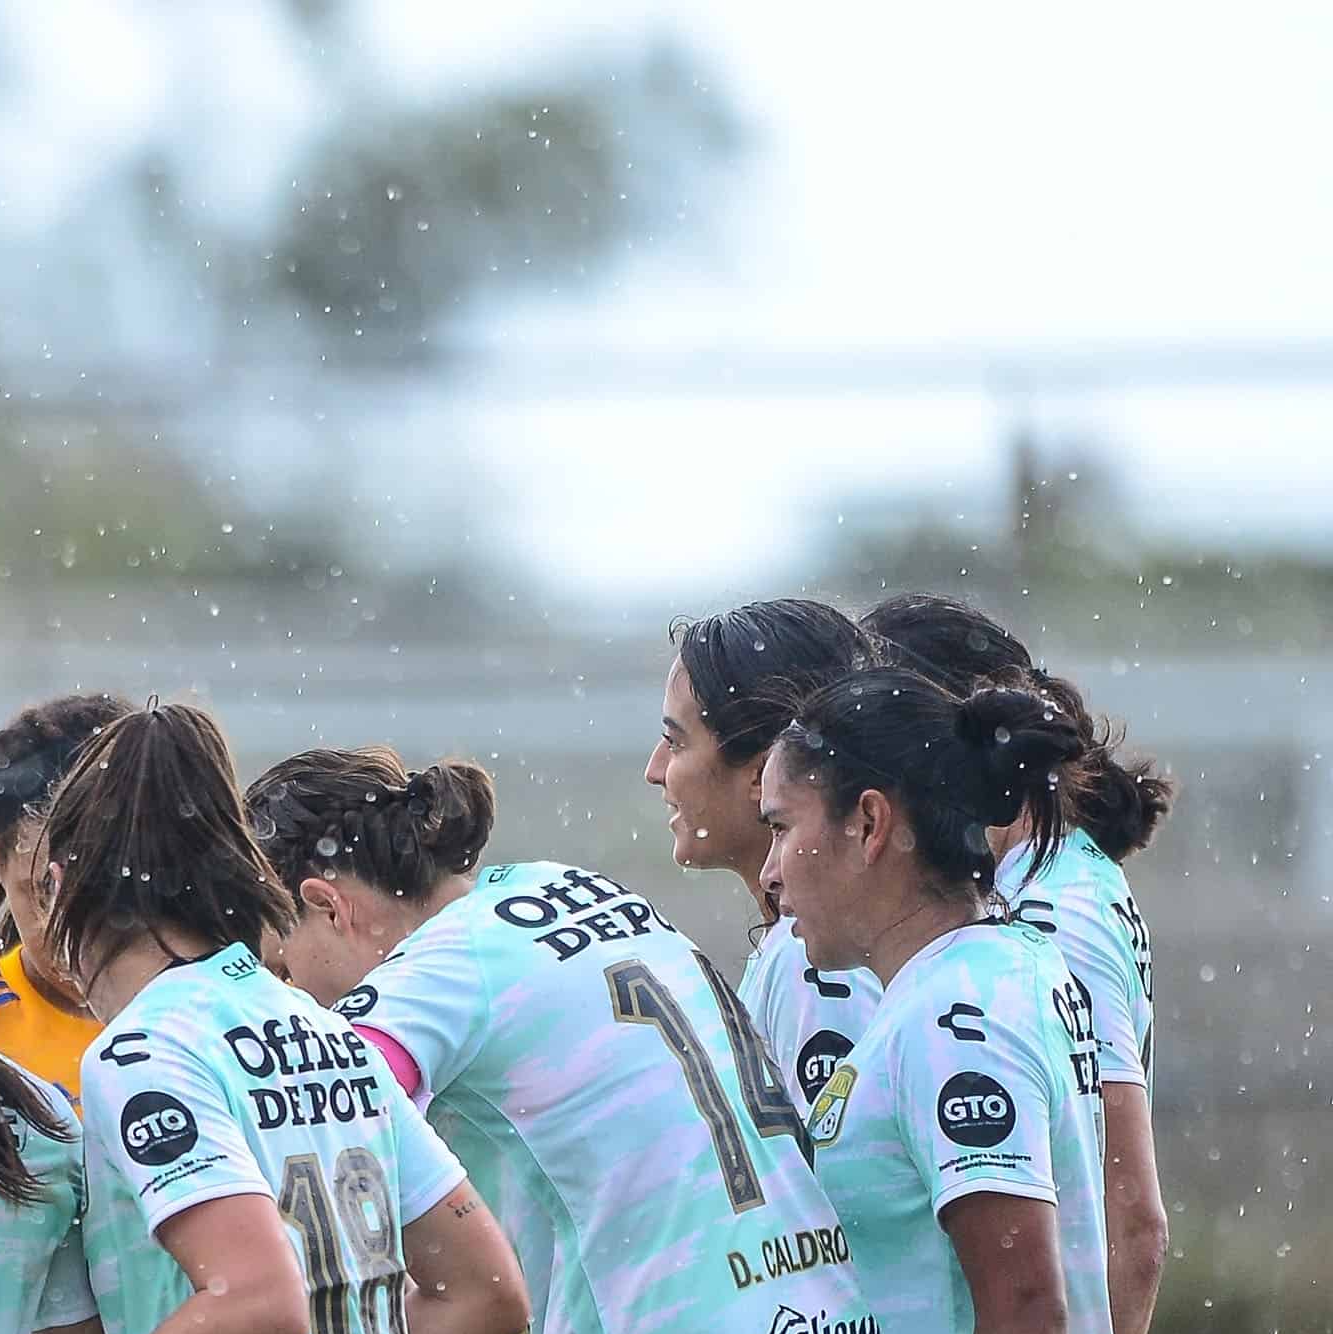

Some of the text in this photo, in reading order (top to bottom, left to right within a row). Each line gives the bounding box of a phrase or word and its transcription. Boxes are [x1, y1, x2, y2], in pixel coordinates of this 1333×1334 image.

[223, 1014, 368, 1079] Office
[247, 1076, 380, 1130] DEPOT
[604, 958, 816, 1214] 14
[943, 1094, 1008, 1121] GTO
[126, 1108, 188, 1148] GTO
